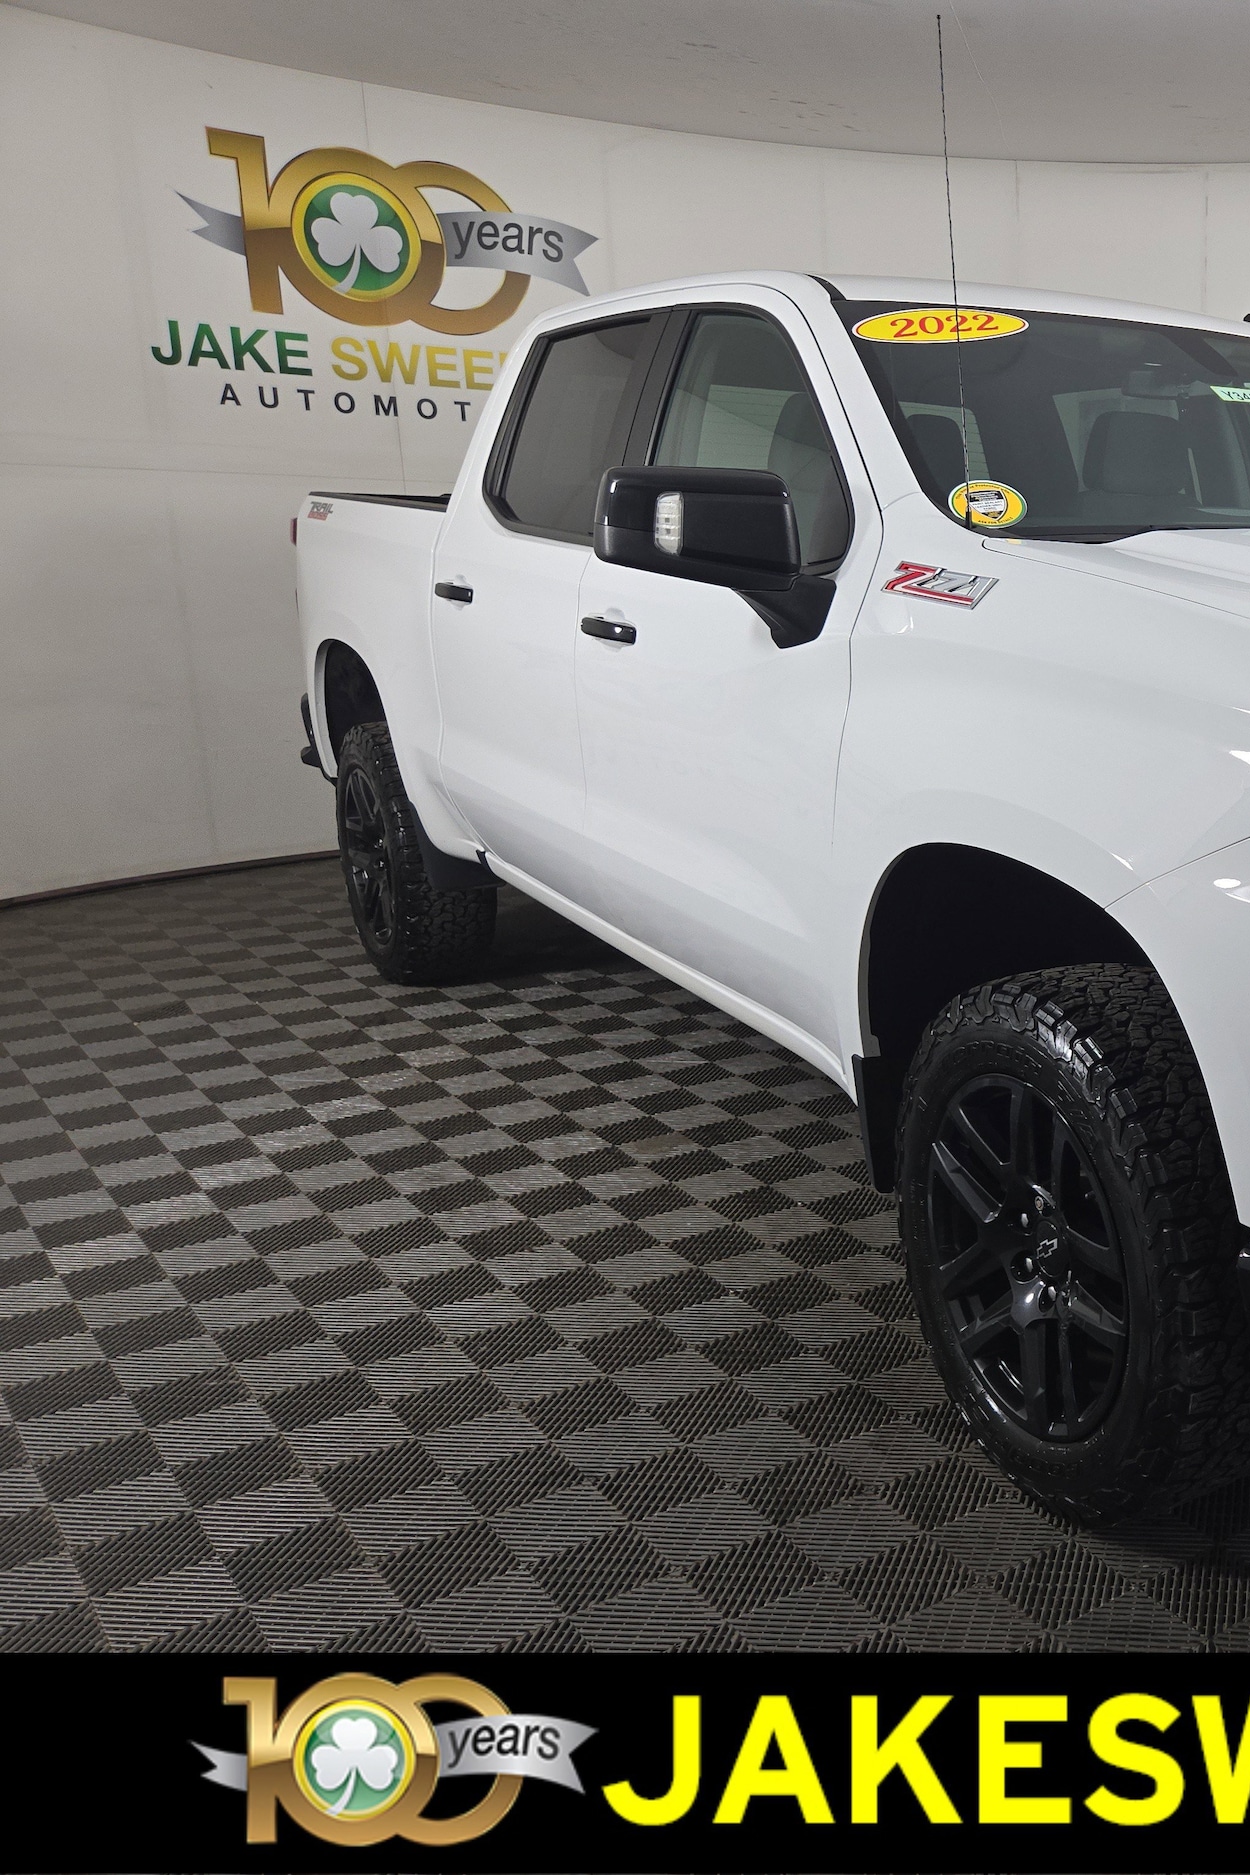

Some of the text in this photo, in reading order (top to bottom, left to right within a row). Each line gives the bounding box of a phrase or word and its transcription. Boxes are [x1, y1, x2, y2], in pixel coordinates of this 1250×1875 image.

[205, 126, 565, 336] 100 years
[889, 314, 999, 338] 2022
[151, 319, 508, 392] JAKE SWEE
[219, 383, 471, 422] AUTOMOT
[310, 501, 334, 514] TRAIL
